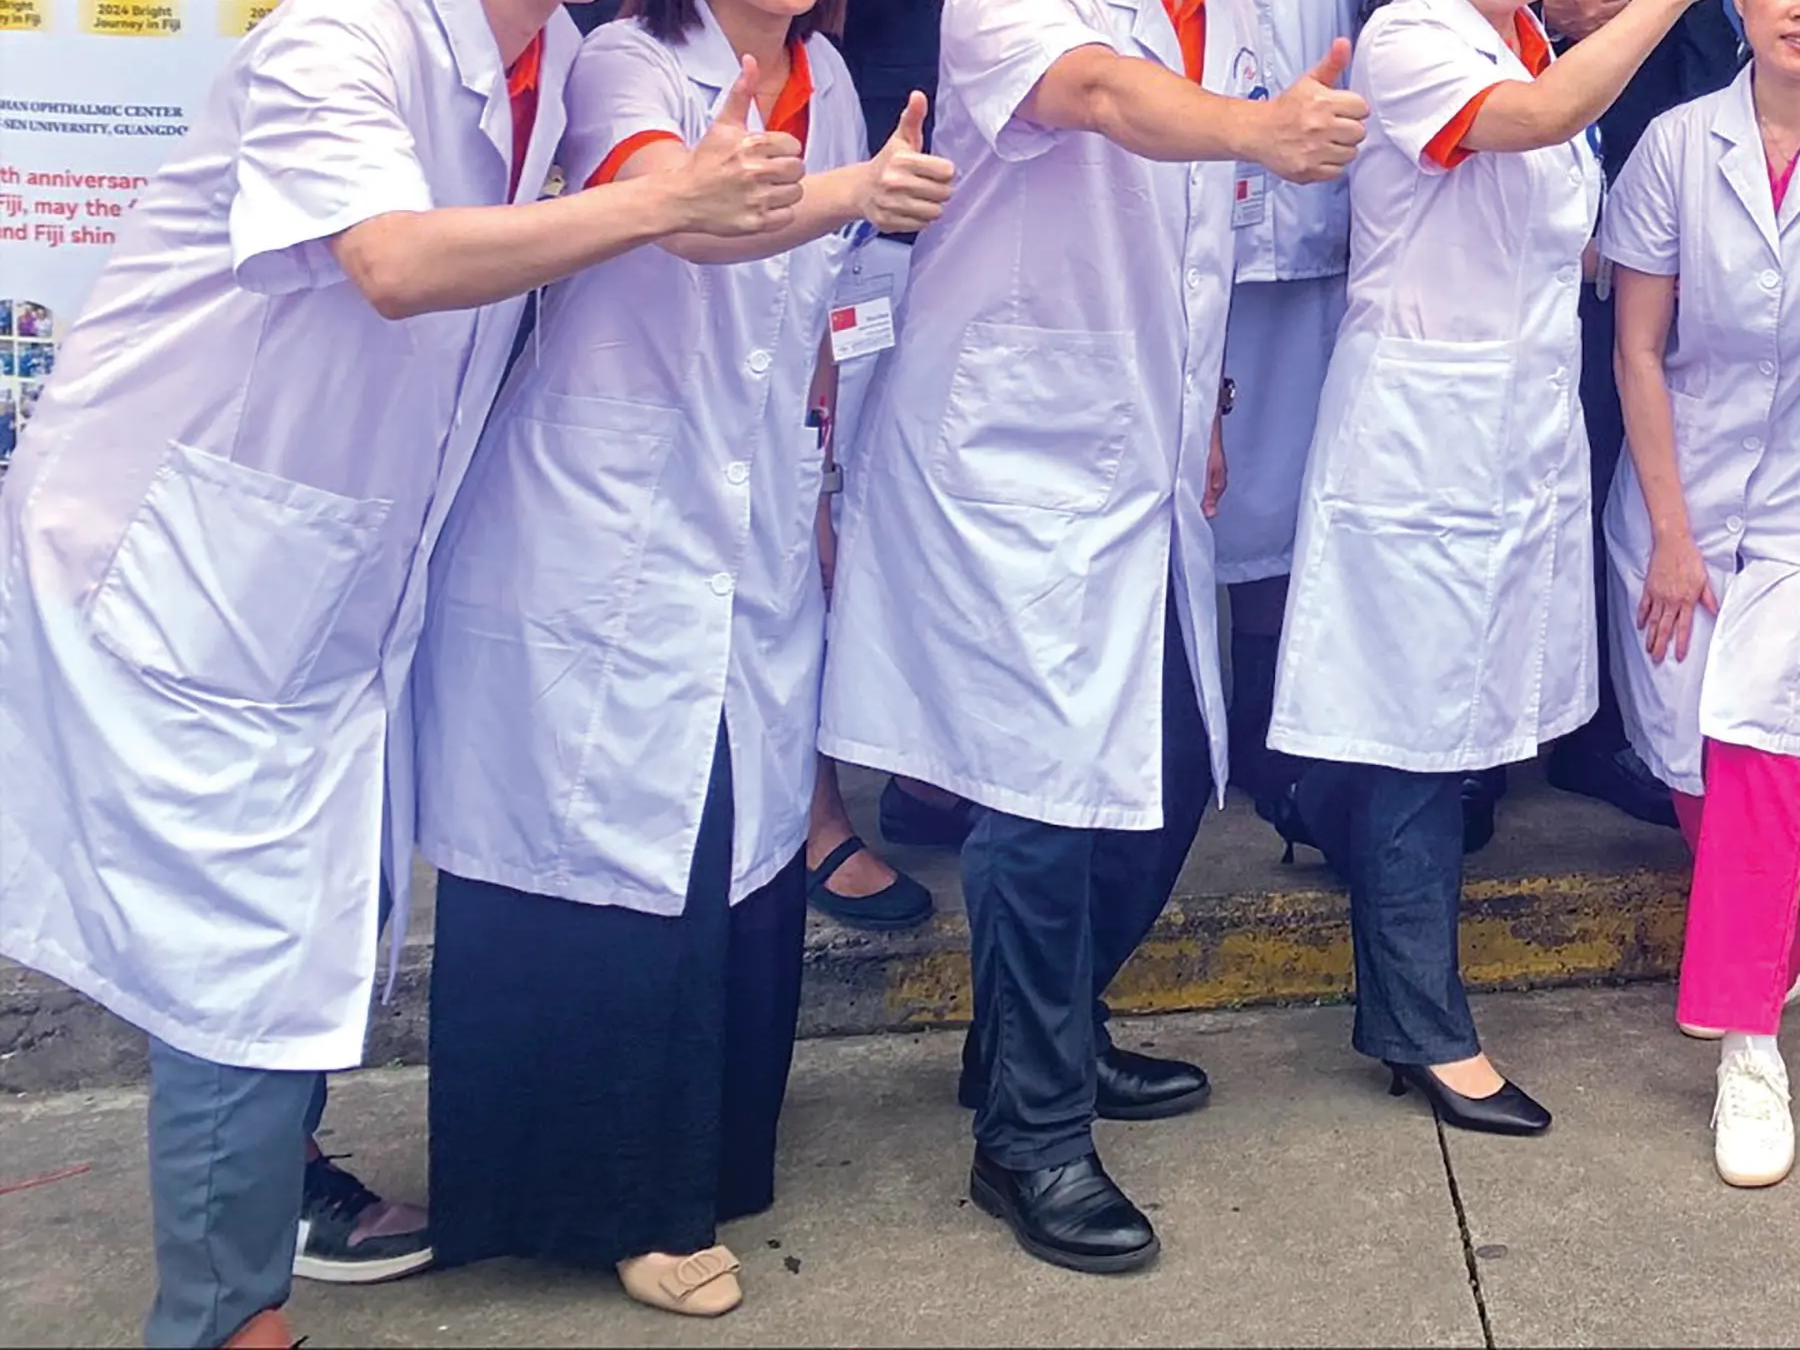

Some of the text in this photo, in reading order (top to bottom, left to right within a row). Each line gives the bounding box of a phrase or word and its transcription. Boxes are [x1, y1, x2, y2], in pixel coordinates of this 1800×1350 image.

[97, 3, 173, 18] 2024 Bright
[93, 17, 143, 31] Journey
[146, 18, 159, 30] in
[30, 102, 122, 117] OPHTHALMIC
[124, 105, 183, 118] CENTER
[29, 120, 113, 136] UNIVERSITY,
[34, 200, 78, 220] may
[86, 198, 122, 217] the
[0, 223, 27, 241] nd
[35, 224, 64, 247] Fiji
